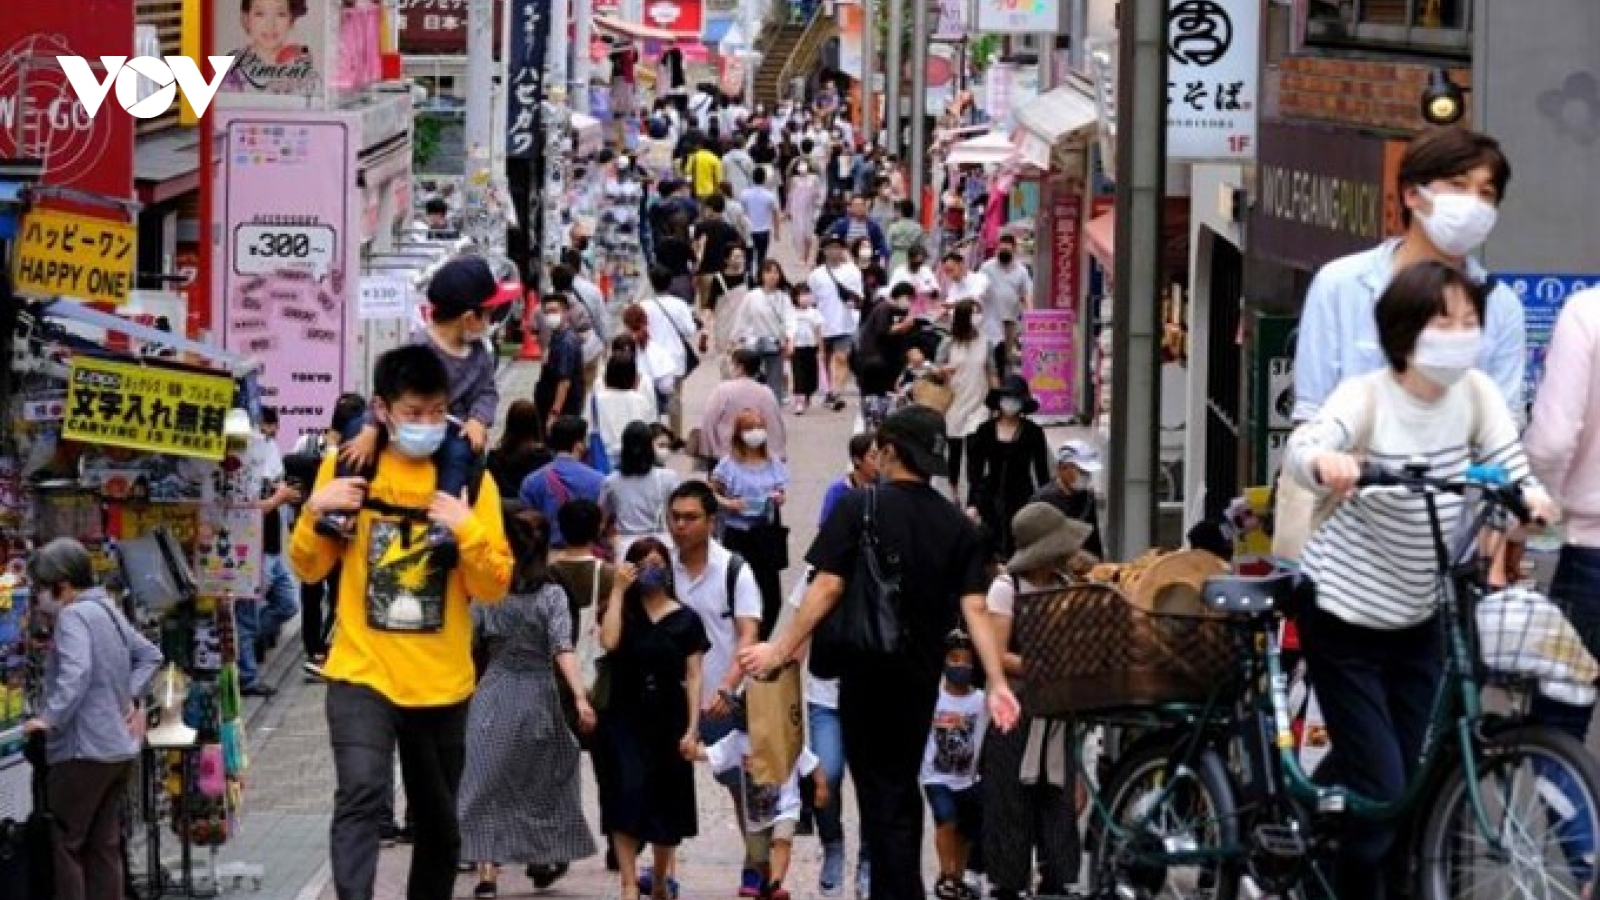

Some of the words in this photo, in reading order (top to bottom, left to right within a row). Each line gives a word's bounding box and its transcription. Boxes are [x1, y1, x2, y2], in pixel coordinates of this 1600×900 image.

[1226, 134, 1251, 153] 1F
[25, 222, 132, 259] ハッピーワン
[19, 256, 83, 291] HAPPY
[291, 371, 333, 383] TOKYO
[70, 389, 227, 437] 文字入れ無料
[67, 417, 140, 440] CARVING
[146, 428, 163, 443] IS
